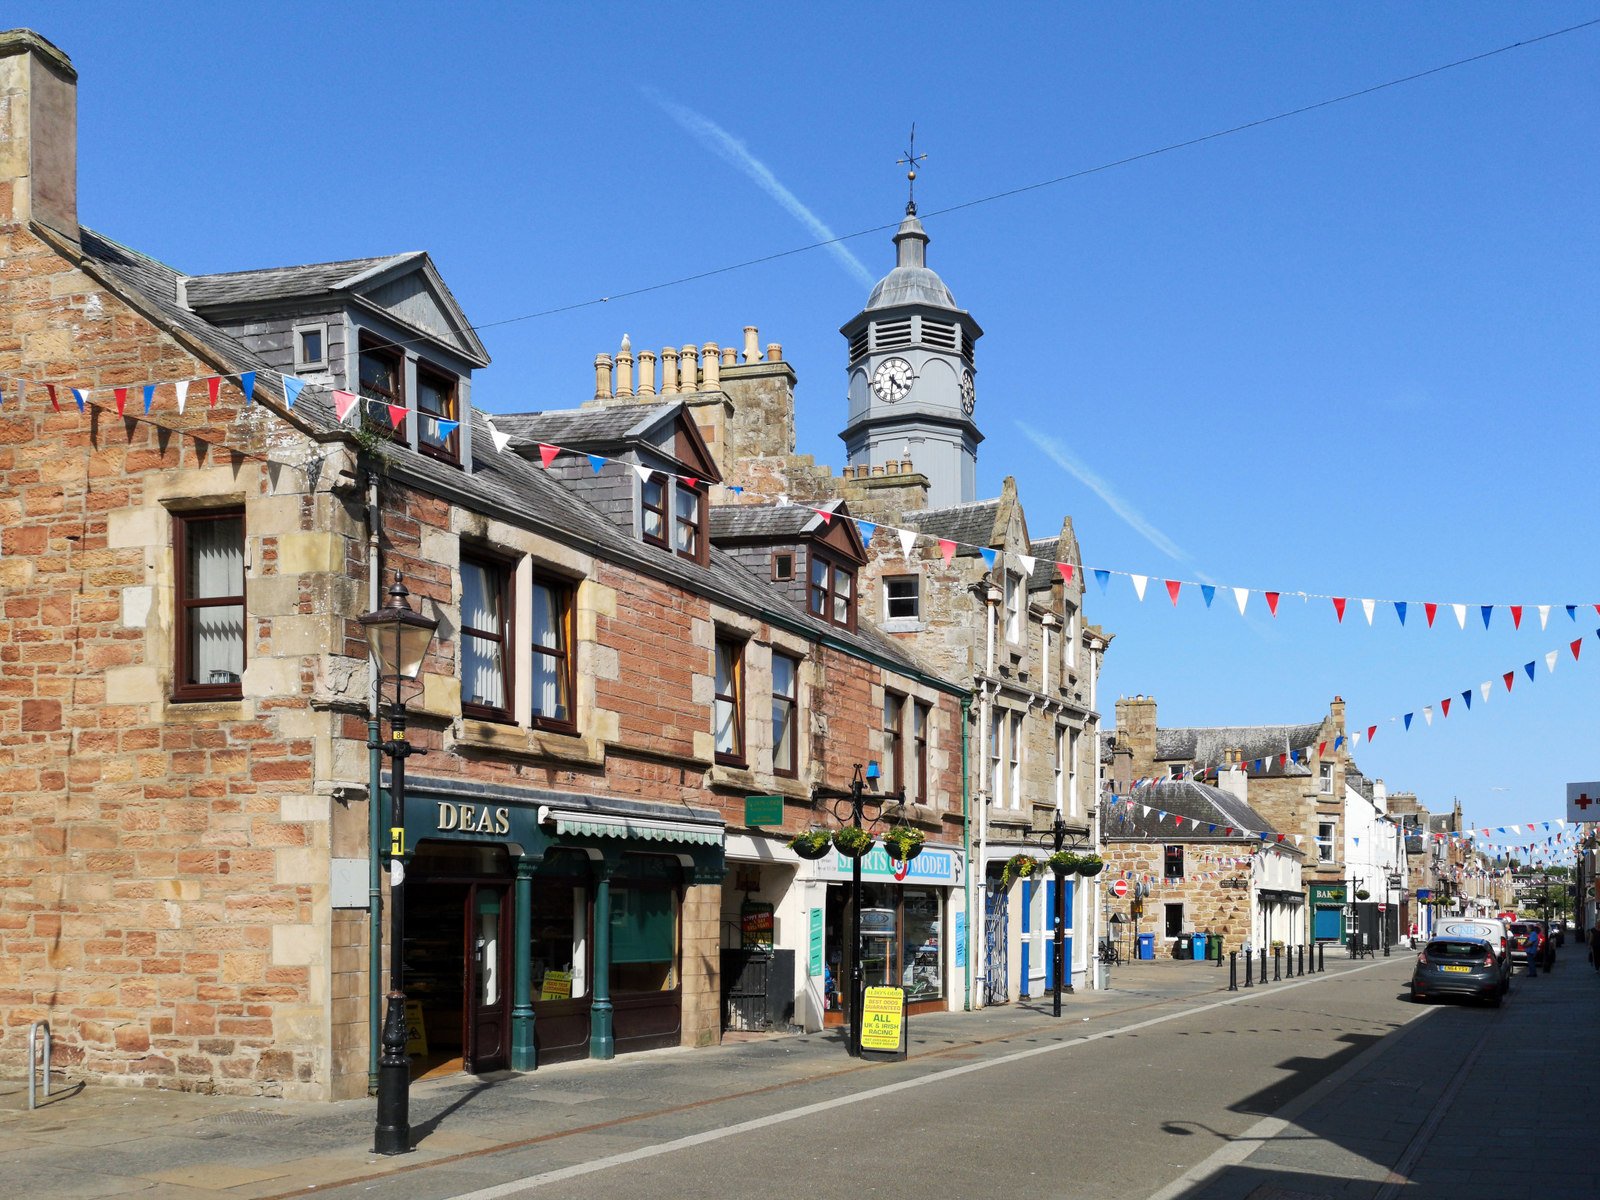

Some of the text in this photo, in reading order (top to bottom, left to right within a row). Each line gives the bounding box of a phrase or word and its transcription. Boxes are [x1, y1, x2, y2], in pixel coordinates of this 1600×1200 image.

[436, 801, 510, 834] DEAS
[840, 850, 887, 871] SRTS
[911, 855, 949, 874] MODEL
[873, 1014, 891, 1022] ALL
